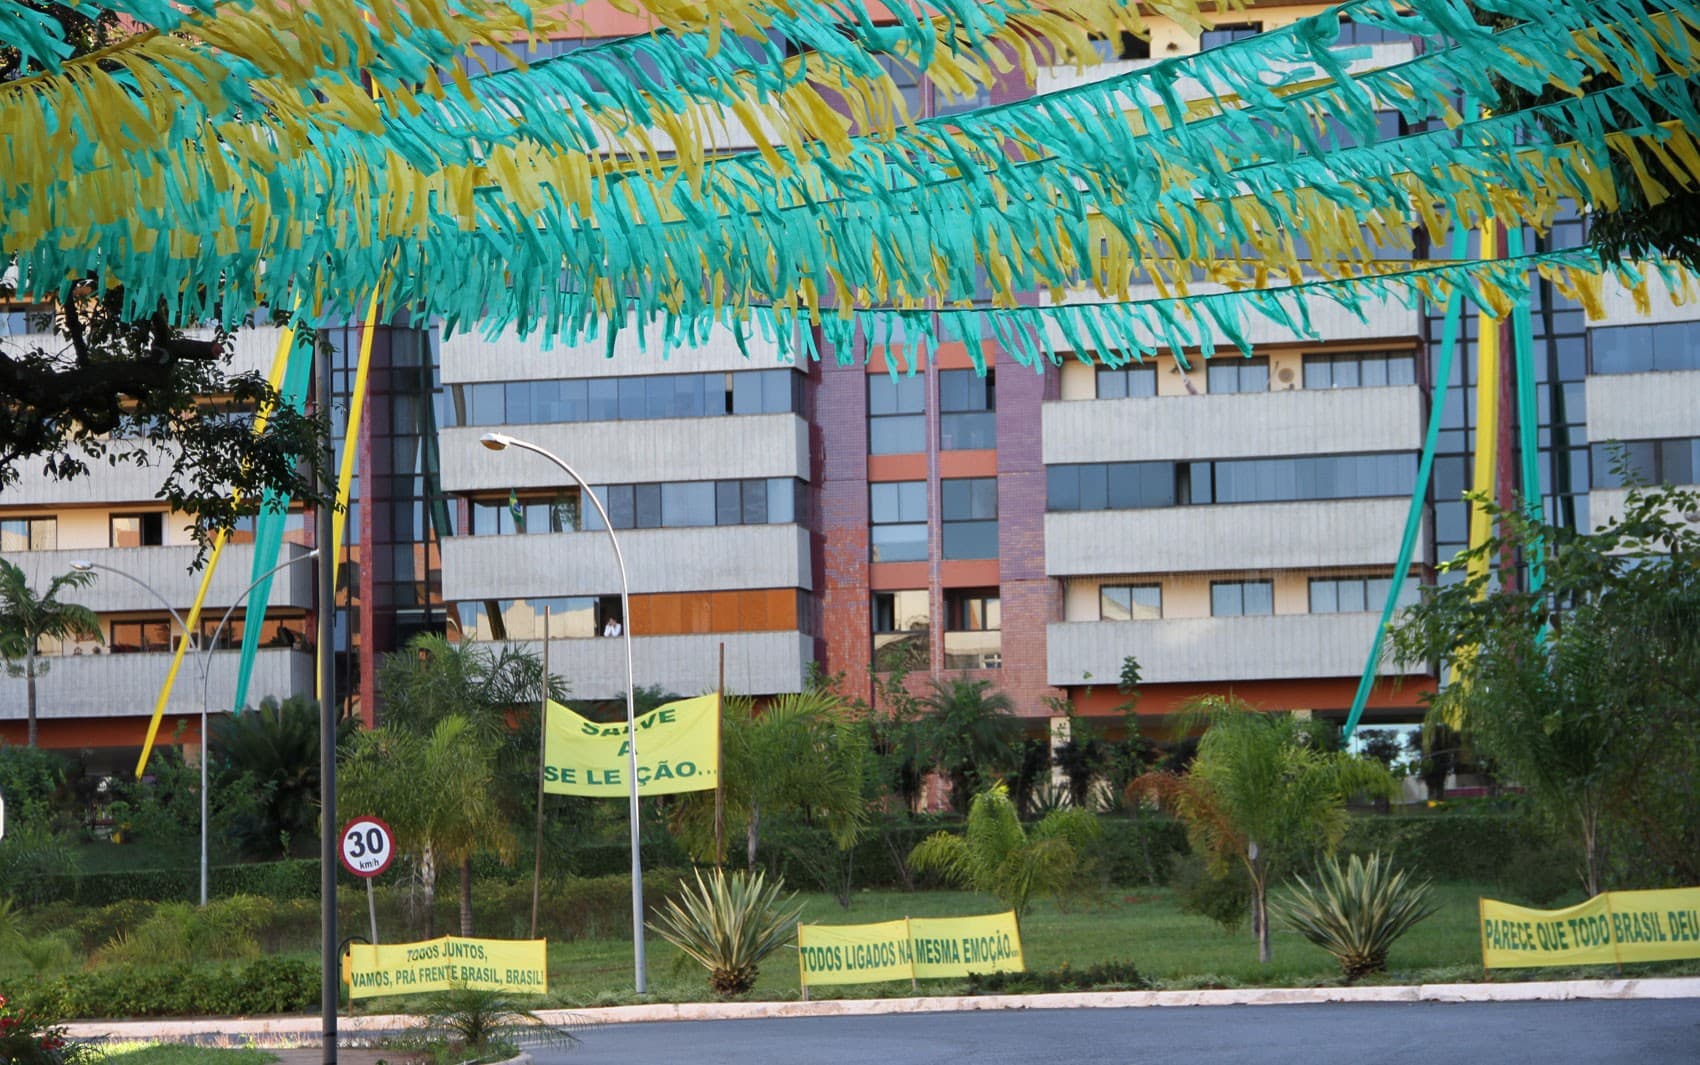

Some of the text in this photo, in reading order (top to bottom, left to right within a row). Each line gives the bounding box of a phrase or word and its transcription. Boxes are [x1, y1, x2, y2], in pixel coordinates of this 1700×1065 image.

[617, 740, 638, 757] A
[347, 827, 384, 858] 30
[359, 858, 380, 870] km/h
[1484, 909, 1700, 951] PARECE QUE TODO BRASIL DEU
[407, 942, 488, 963] TODOS JUNTOS,
[801, 944, 842, 973] TODOS
[845, 941, 897, 970] LIGADOS
[897, 938, 913, 965] NA
[914, 938, 960, 965] MESMA
[351, 970, 393, 988] VAMOS,
[419, 965, 458, 983] FRENTE
[461, 966, 503, 985] BRASIL,
